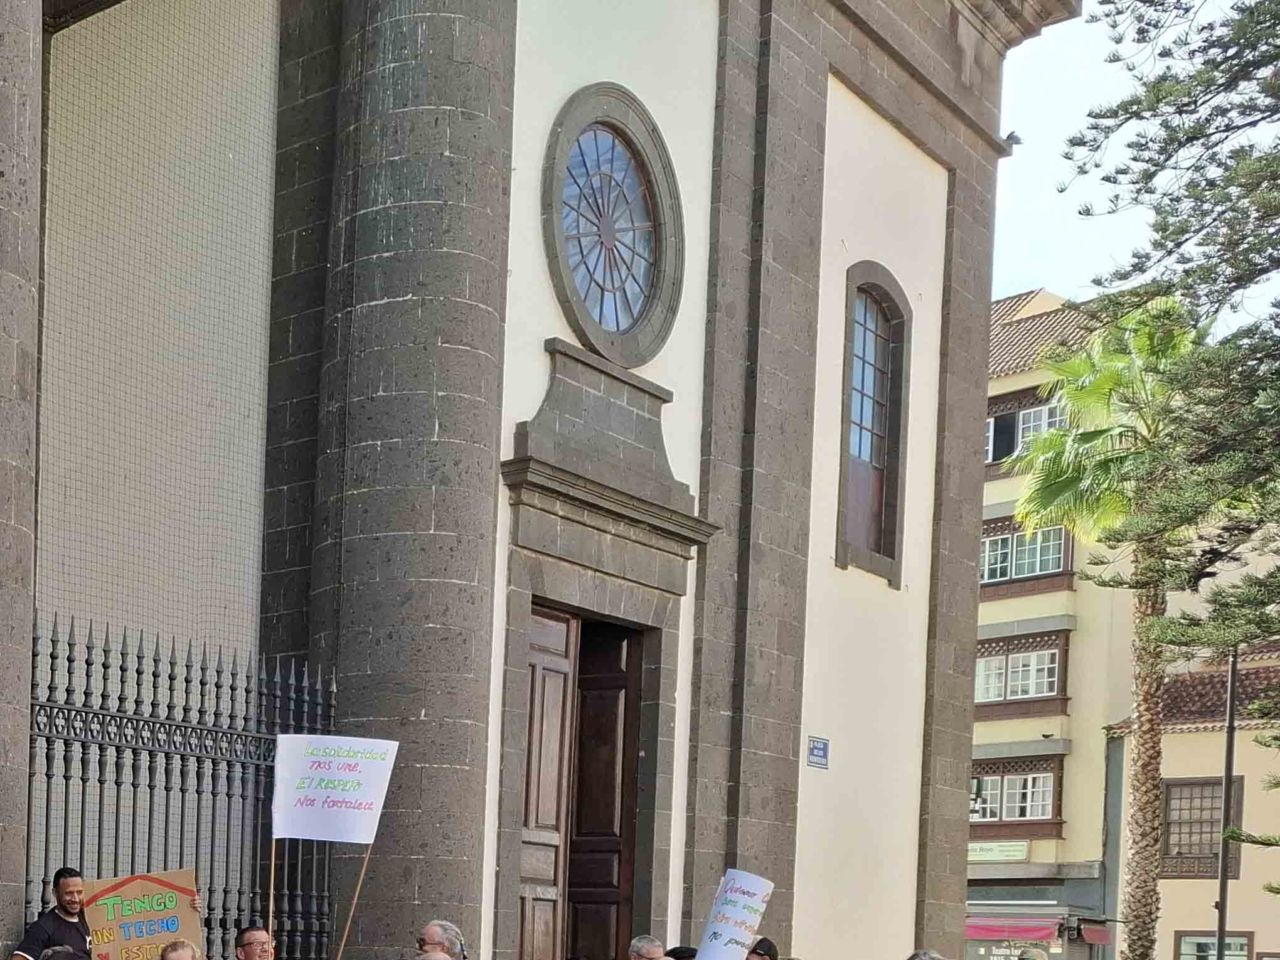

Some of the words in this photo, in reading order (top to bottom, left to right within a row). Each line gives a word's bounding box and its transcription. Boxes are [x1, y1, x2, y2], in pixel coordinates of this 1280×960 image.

[95, 891, 178, 921] TENGO
[92, 927, 115, 945] UN
[119, 915, 180, 940] TECHO
